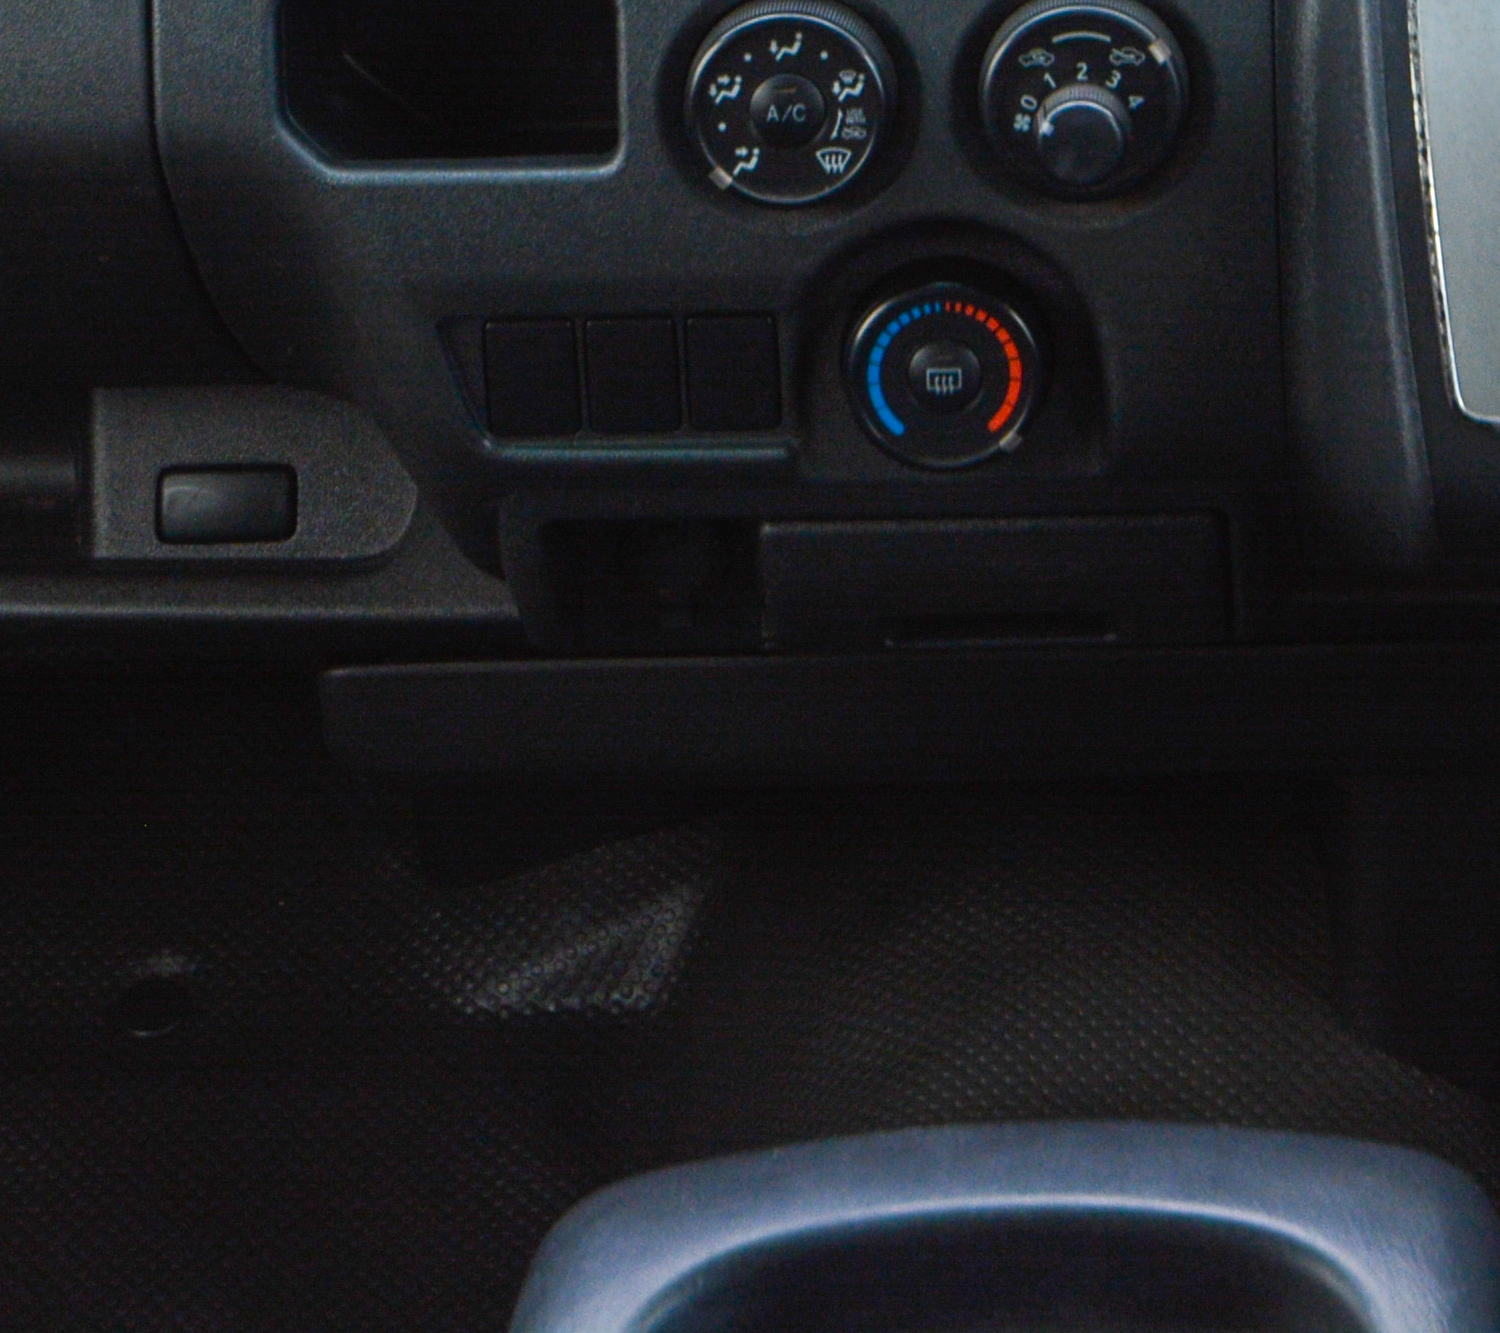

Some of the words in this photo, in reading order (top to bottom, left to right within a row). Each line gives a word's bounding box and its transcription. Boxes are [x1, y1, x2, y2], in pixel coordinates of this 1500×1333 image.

[1044, 72, 1057, 89] 1
[1076, 62, 1089, 82] 2
[1105, 69, 1121, 89] 3
[766, 104, 807, 122] A/C
